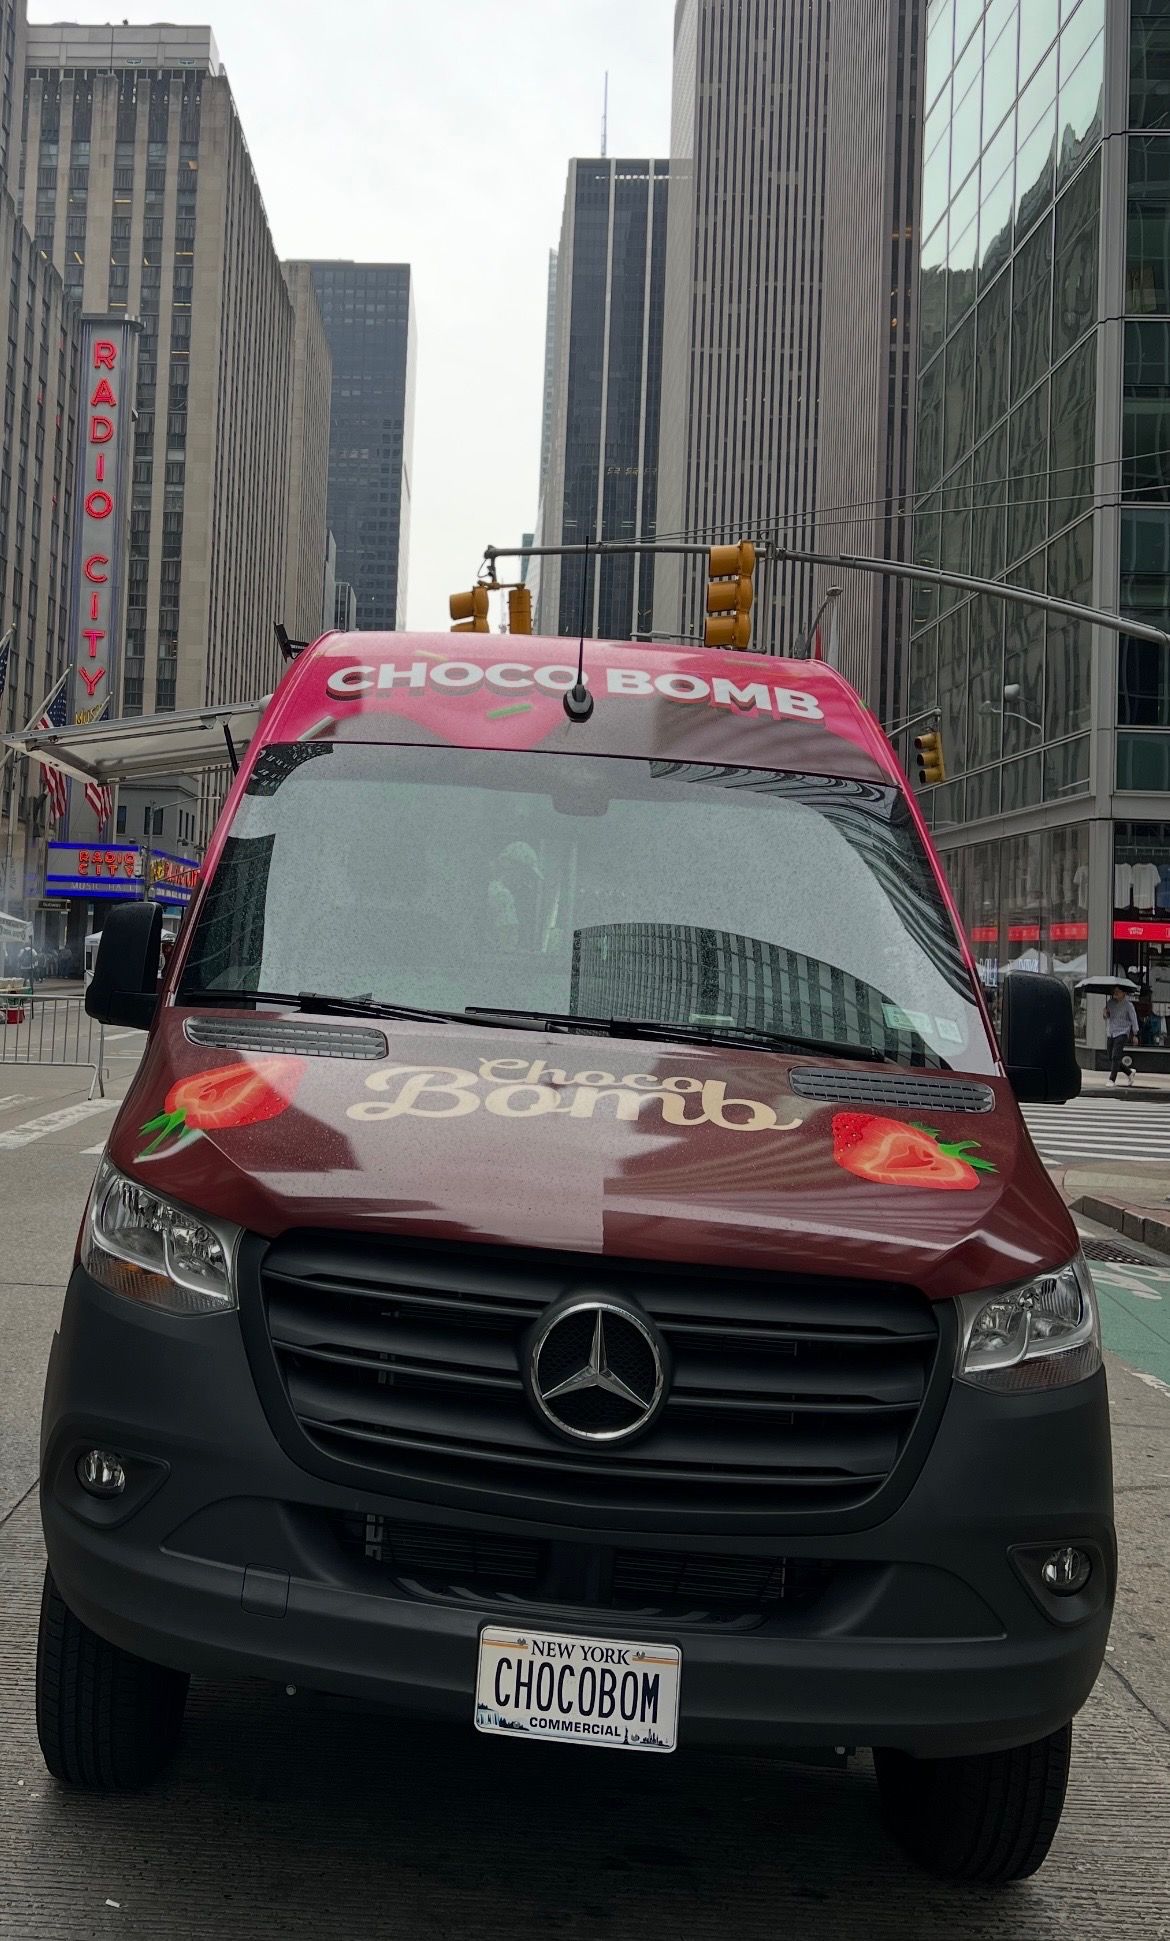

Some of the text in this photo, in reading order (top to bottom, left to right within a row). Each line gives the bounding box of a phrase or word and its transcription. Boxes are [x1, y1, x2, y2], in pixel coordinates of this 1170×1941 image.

[79, 340, 117, 696] RADIO CITY
[326, 661, 825, 721] CHOCO BOMB
[78, 863, 135, 877] CITY
[79, 850, 135, 865] RADIO
[70, 882, 100, 891] MUSIC
[479, 1057, 704, 1093] Choco
[346, 1065, 803, 1131] Bomb
[531, 1640, 630, 1666] NEW YORK
[494, 1657, 660, 1724] CHOCOBOM
[529, 1716, 622, 1737] COMMERCIAL
